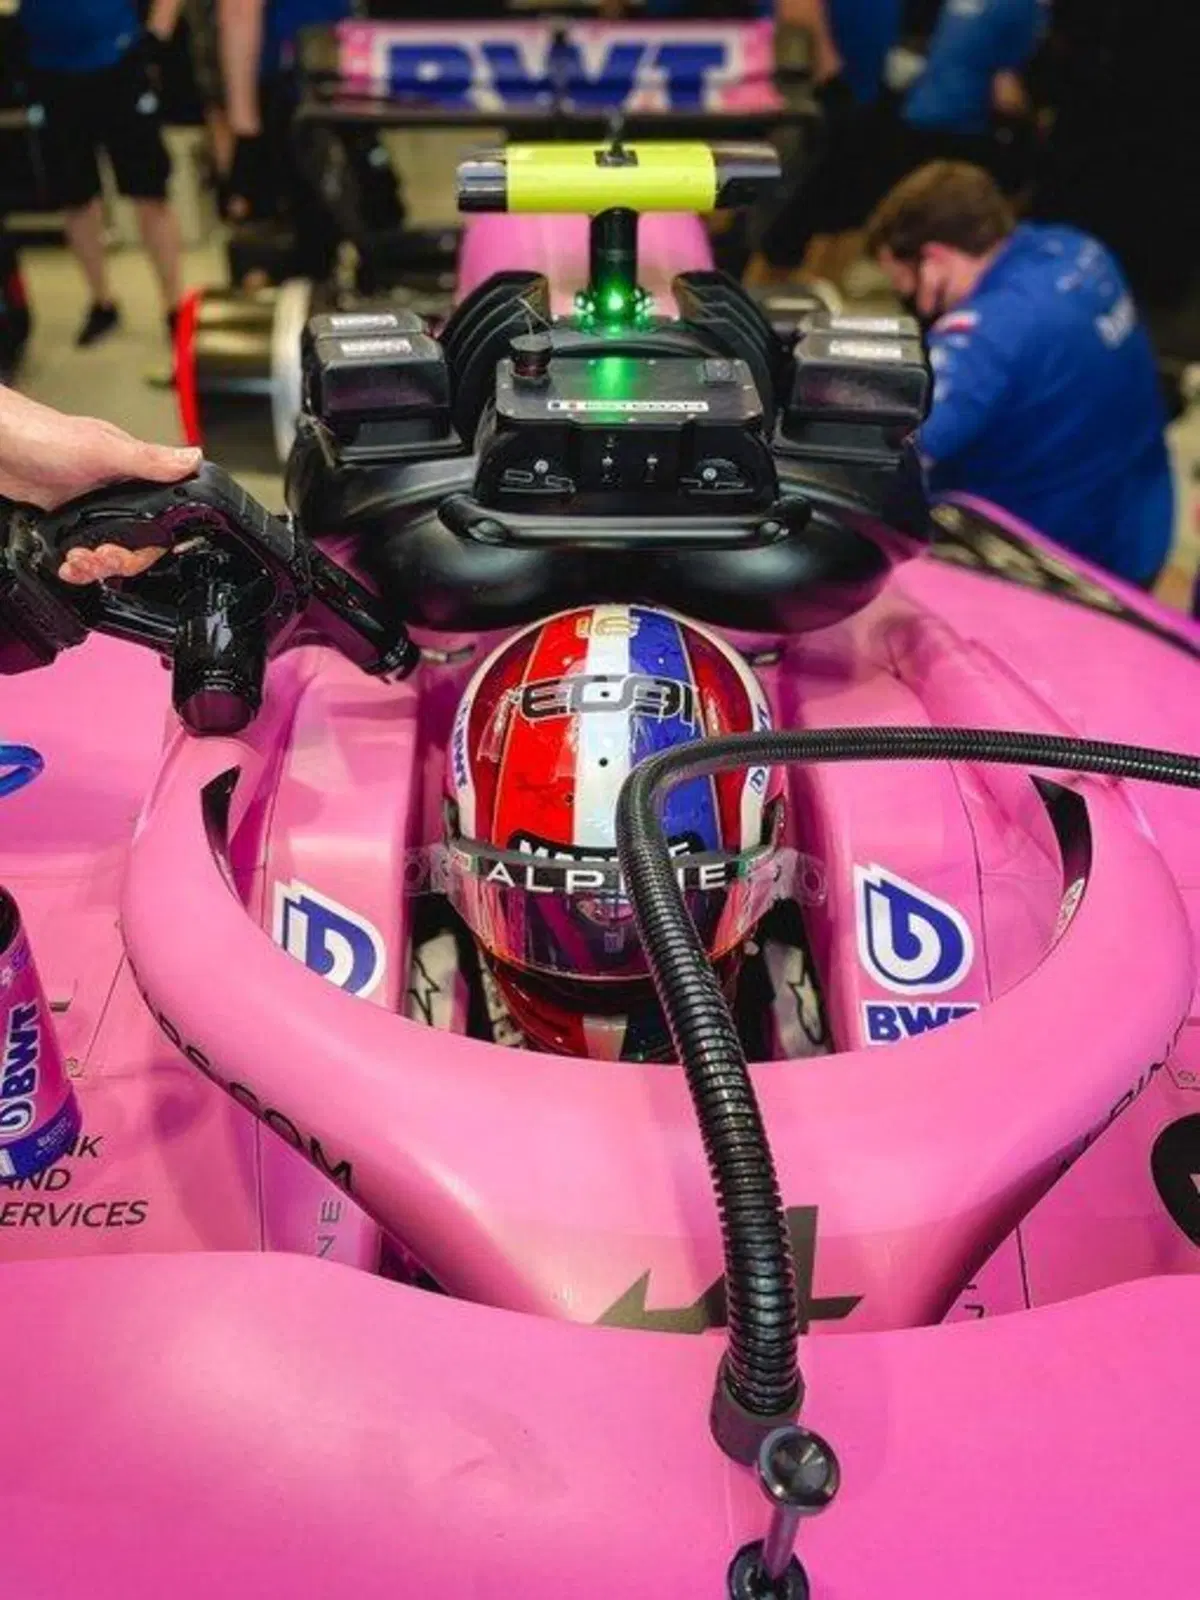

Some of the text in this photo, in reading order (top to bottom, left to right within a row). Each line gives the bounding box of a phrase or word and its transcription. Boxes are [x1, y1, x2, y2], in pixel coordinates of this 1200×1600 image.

[388, 43, 727, 111] BWT
[1, 1003, 38, 1096] BWT
[0, 1201, 147, 1227] ERVICES
